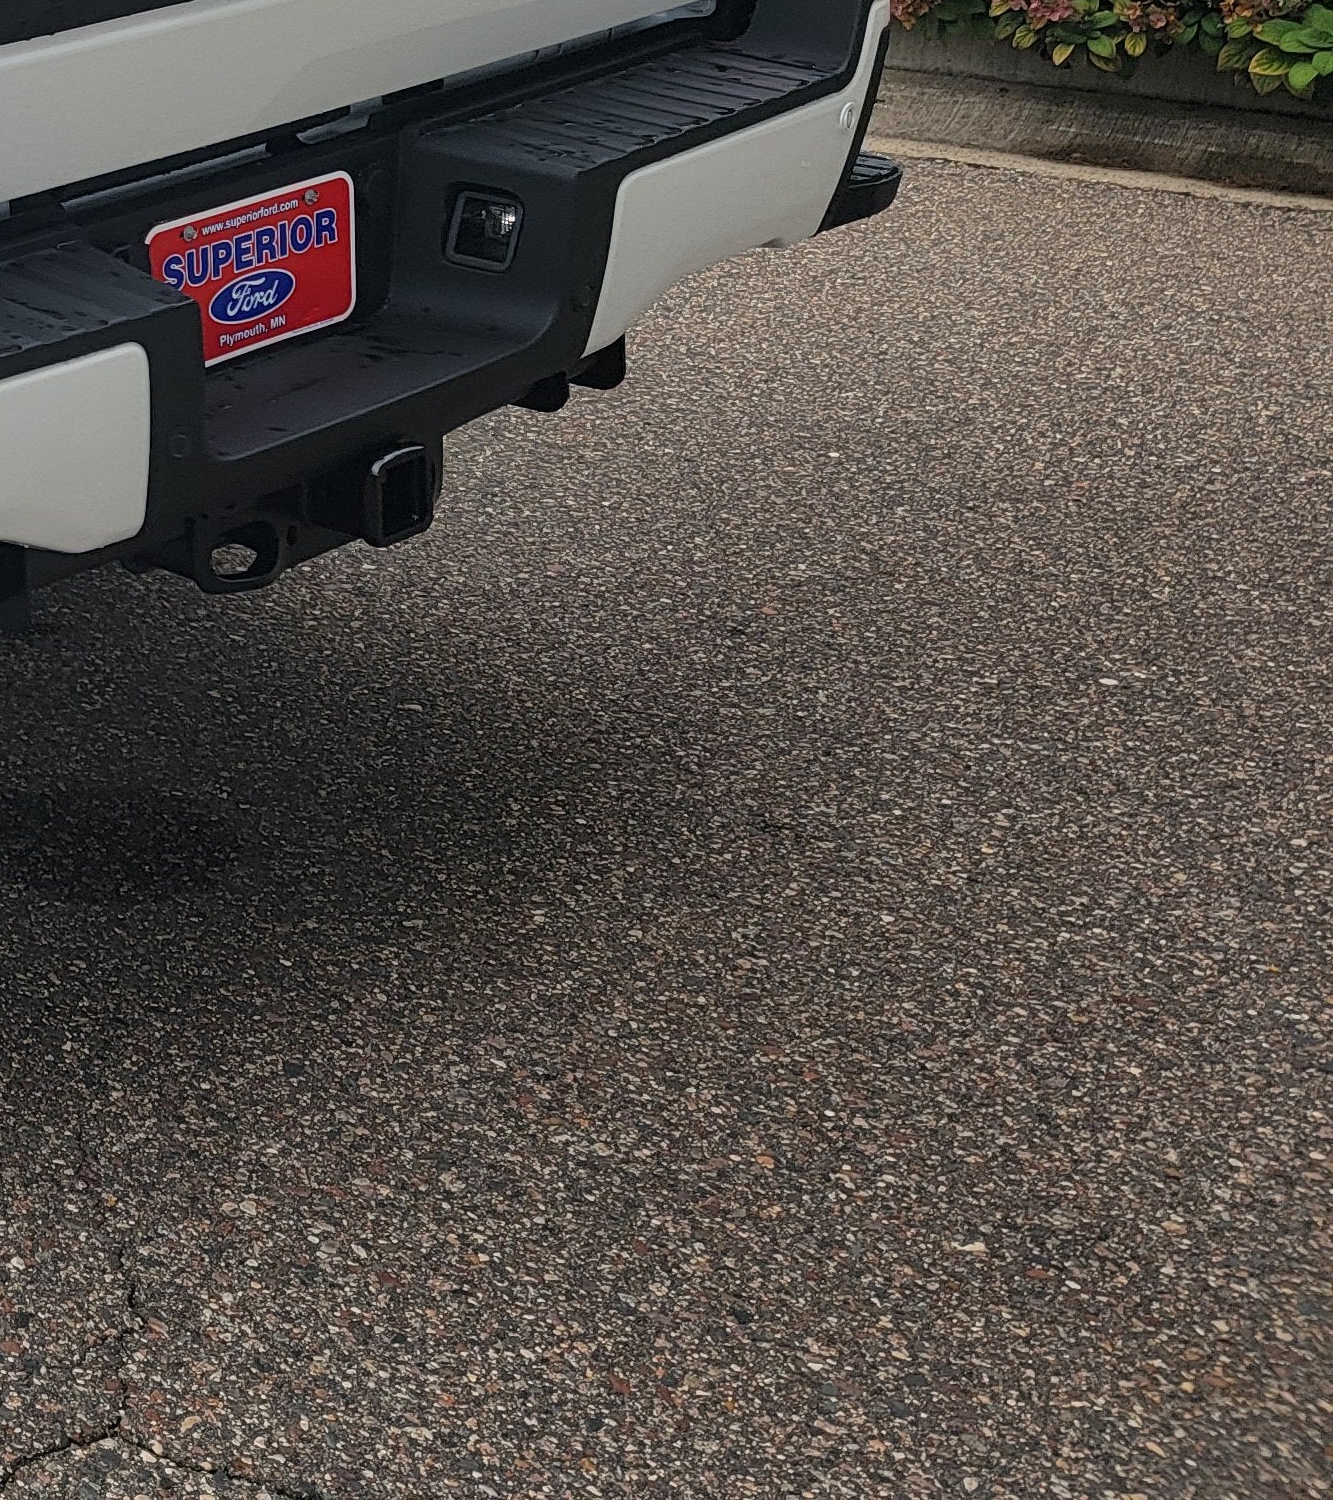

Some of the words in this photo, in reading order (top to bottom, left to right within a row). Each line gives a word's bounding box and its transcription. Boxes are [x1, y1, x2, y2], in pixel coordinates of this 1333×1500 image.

[201, 199, 299, 236] www.superiorford.com
[162, 208, 339, 291] SUPERIOR
[226, 276, 280, 317] Ford
[219, 321, 269, 348] Plymouth,
[270, 314, 286, 331] MN
